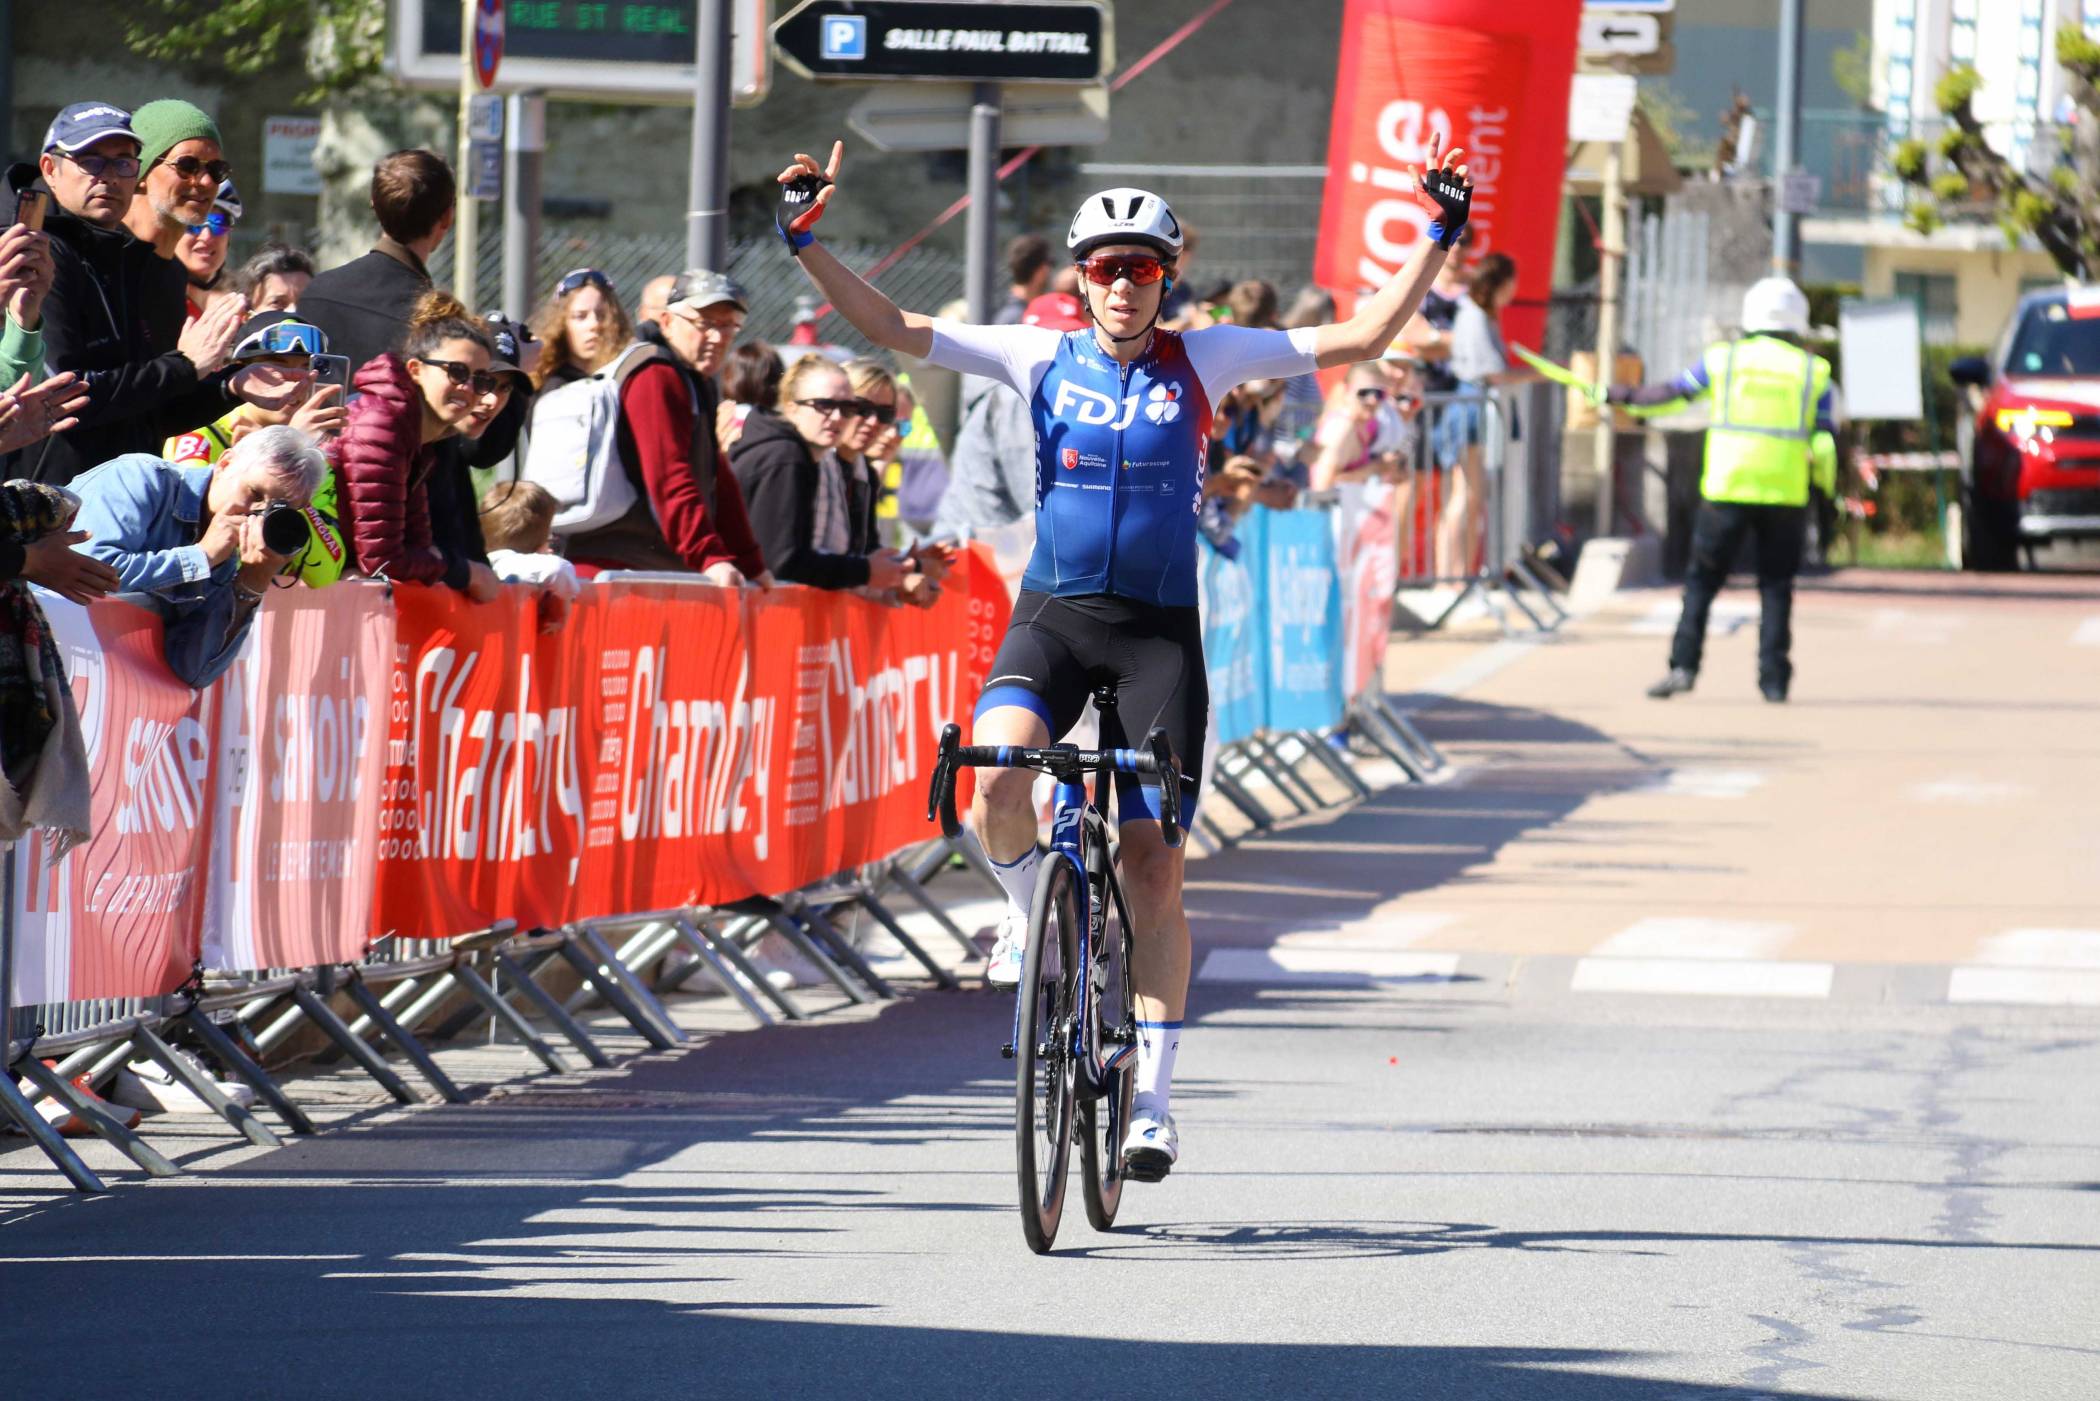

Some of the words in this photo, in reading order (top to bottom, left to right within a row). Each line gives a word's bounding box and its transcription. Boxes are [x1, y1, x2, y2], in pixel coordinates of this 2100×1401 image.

[511, 1, 560, 29] RUE
[575, 3, 607, 30] ST
[623, 4, 688, 33] REAL
[829, 22, 854, 52] P
[884, 28, 950, 50] SALLE
[951, 30, 1005, 51] PAUL
[1007, 31, 1091, 54] BATTAIL
[1439, 182, 1465, 201] GOBIK
[1052, 379, 1140, 431] FDJ
[306, 505, 338, 556] BINGOAL
[271, 656, 371, 804] savoie
[84, 870, 113, 912] LE
